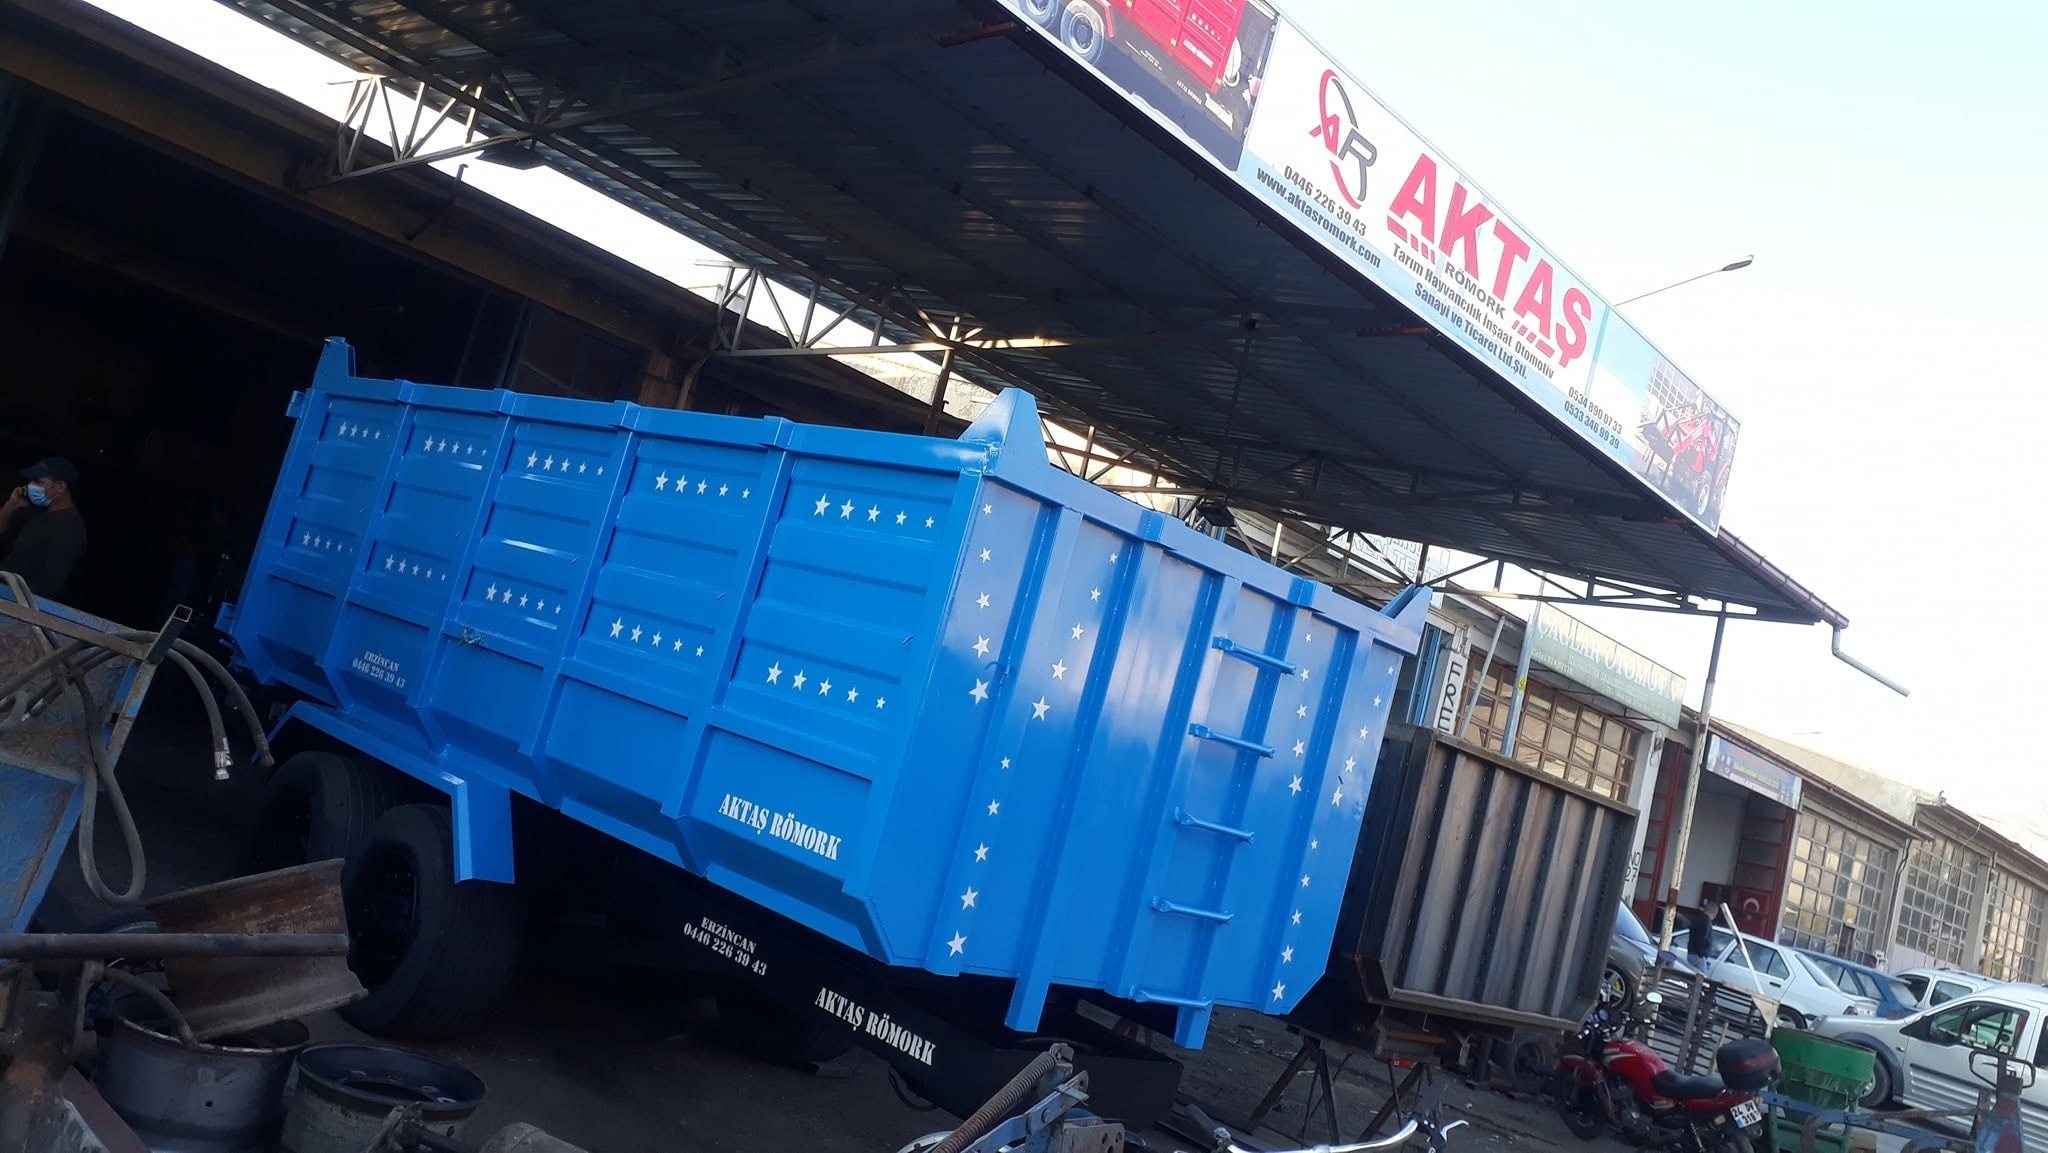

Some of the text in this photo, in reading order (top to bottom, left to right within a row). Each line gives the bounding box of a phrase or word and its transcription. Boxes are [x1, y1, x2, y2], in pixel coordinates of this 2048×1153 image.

[1256, 167, 1382, 269] www.aktasromork.com
[1284, 165, 1367, 237] 0446 226 39 43
[1389, 153, 1592, 368] AKTAŞ
[1445, 262, 1507, 320] RÖMORK
[1392, 243, 1555, 380] Tarım Hayvancılık İnşaat Otomotiv
[1414, 282, 1528, 380] Sanayi ve Ticaret Ltd.Şti.
[1564, 400, 1620, 449] 0533 346 99 39
[1568, 386, 1623, 435] 0534 890 07 33
[352, 657, 406, 688] 0446 226 39 43
[364, 650, 399, 672] ERZİNCAN
[718, 793, 842, 861] AKTAŞ RÖMORK
[683, 922, 767, 976] 0446 226 39 43
[701, 916, 757, 954] ERZİNCAN
[814, 986, 937, 1066] AKTAŞ RÖMORK
